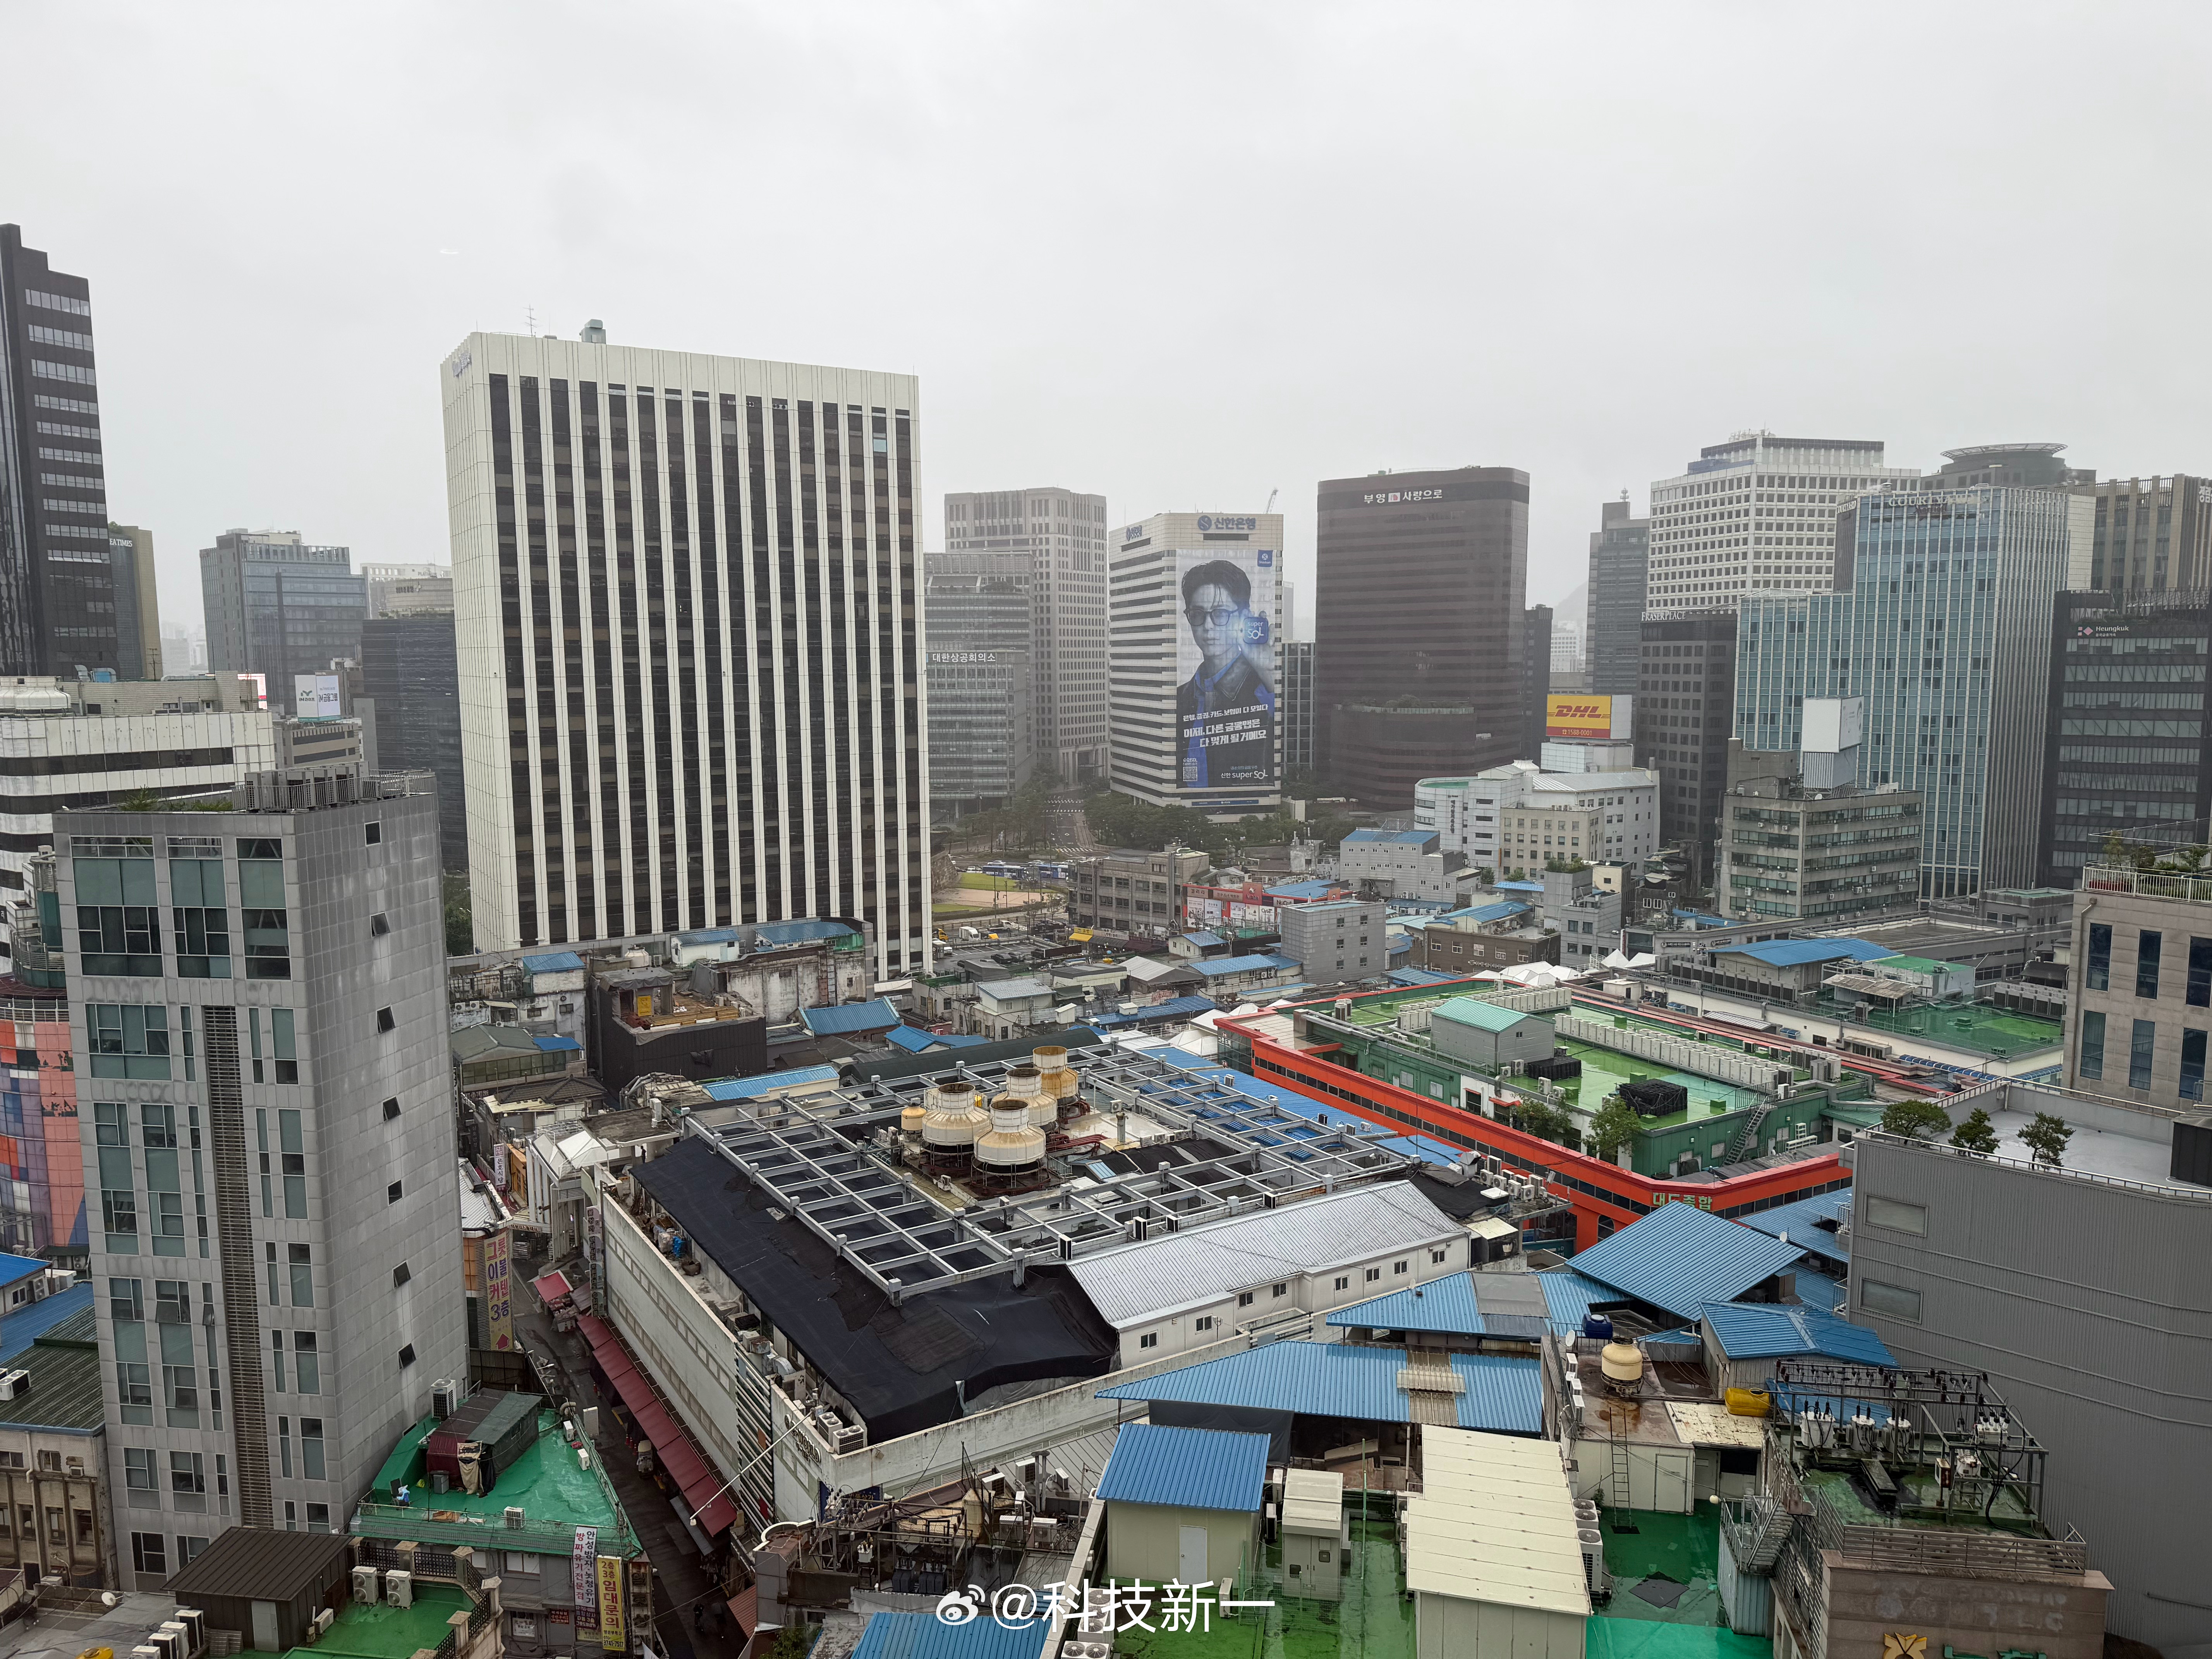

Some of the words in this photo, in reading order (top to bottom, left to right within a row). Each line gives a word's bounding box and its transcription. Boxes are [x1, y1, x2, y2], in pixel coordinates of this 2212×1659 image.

[1364, 494, 1385, 503] 부영
[1403, 489, 1442, 501] 사랑으로
[1214, 517, 1255, 530] 신한은행
[1665, 611, 1686, 620] PLACE
[933, 653, 996, 663] 대한상공회의소
[1555, 705, 1602, 718] DHL
[1206, 723, 1224, 735] 다른
[1200, 738, 1209, 747] 다
[1230, 733, 1239, 743] 될
[491, 1299, 509, 1322] 3층
[601, 1561, 614, 1569] 2층
[603, 1570, 615, 1578] 3층
[603, 1580, 620, 1629] 임대문의
